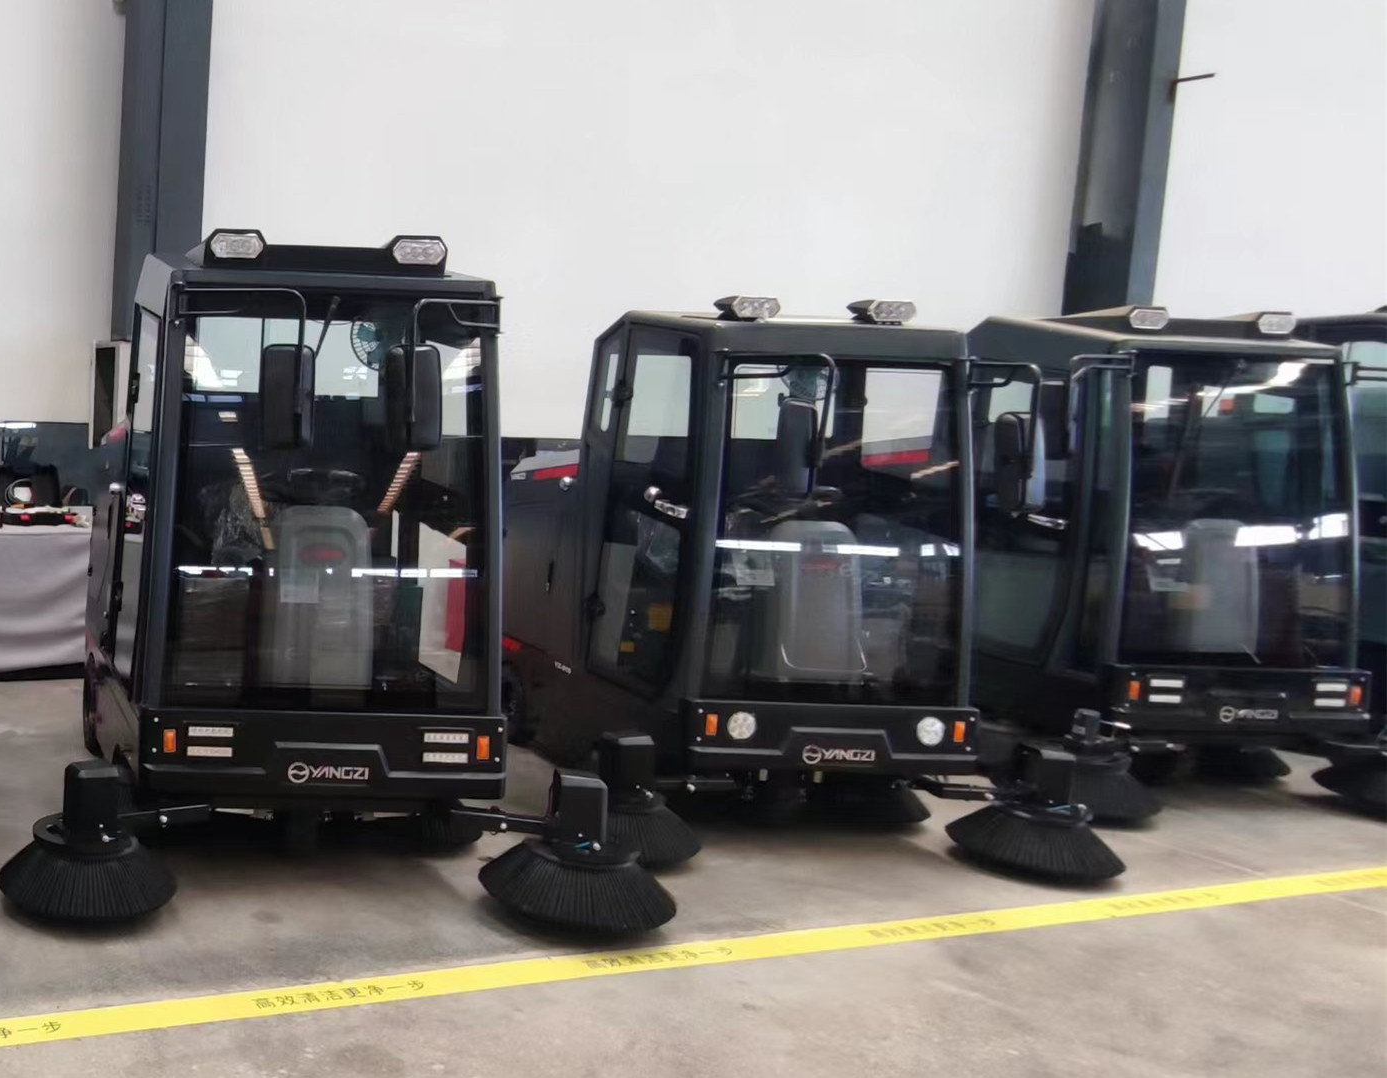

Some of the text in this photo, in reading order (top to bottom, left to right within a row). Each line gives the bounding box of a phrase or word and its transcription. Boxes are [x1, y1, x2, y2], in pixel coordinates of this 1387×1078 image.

[821, 748, 876, 762] YANGZI
[309, 765, 370, 781] YANGZI
[252, 979, 425, 1010] 高效清洁更净一步
